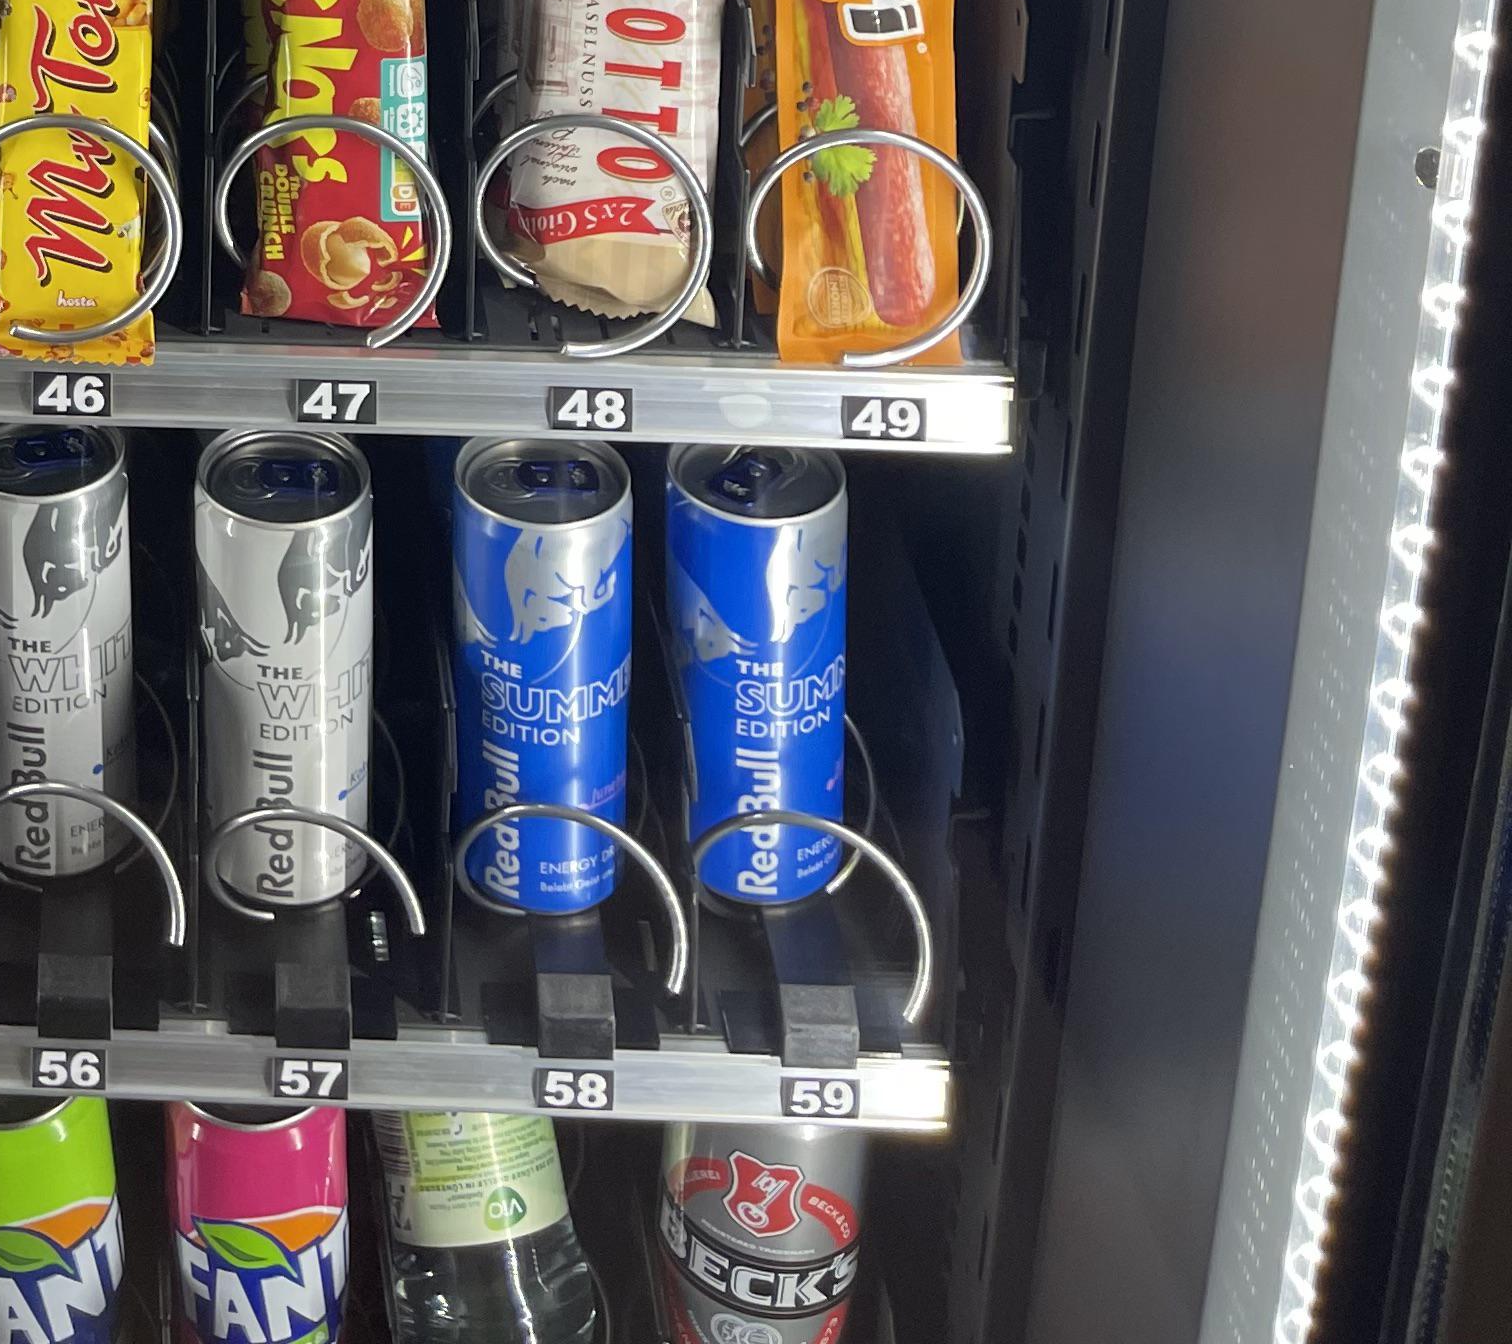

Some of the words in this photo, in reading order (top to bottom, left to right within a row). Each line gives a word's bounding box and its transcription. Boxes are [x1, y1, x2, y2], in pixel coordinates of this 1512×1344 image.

[259, 170, 285, 260] CRUNCH
[274, 163, 296, 235] DOUBLE
[55, 289, 98, 310] hosta
[37, 374, 105, 414] 46
[302, 382, 371, 422] 47
[557, 389, 626, 429] 48
[851, 399, 921, 438] 49
[8, 637, 52, 653] THE
[8, 623, 133, 693] WHIT
[257, 664, 303, 681] THE
[480, 649, 522, 679] THE
[735, 659, 785, 678] THE
[12, 683, 107, 714] EDITION
[482, 710, 581, 747] EDITION
[736, 706, 832, 740] EDITION
[539, 856, 598, 876] ENERGY
[38, 1050, 101, 1087] 56
[279, 1060, 343, 1097] 57
[543, 1070, 608, 1109] 58
[790, 1080, 854, 1116] 59
[177, 1224, 350, 1344] FANT
